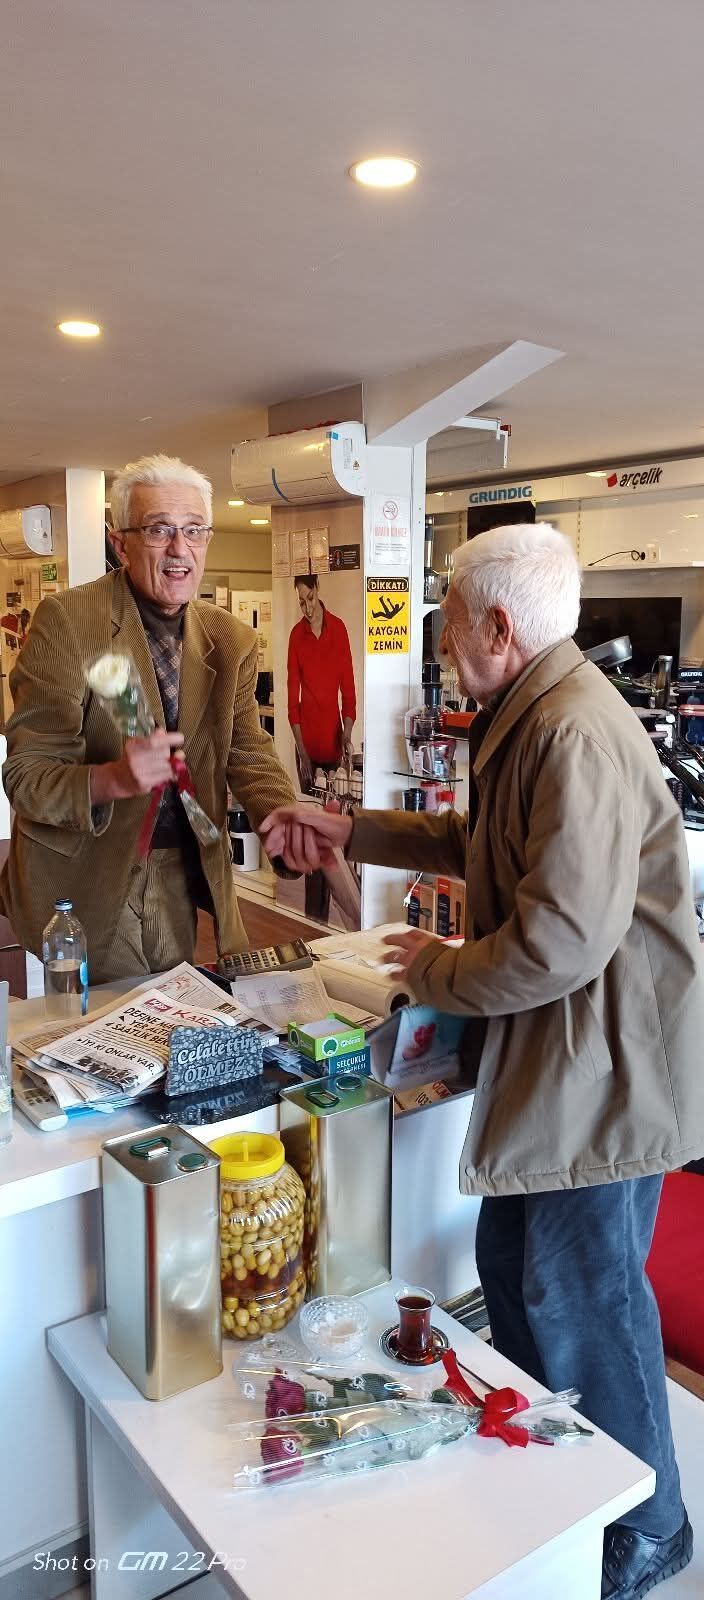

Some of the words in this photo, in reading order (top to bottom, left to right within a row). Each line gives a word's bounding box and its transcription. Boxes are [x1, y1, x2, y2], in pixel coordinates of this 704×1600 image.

[619, 467, 663, 489] arçelik
[469, 486, 533, 504] GRUNDIG
[371, 579, 405, 590] DİKKAT!
[368, 626, 408, 636] KAYGAN
[373, 638, 403, 650] ZEMİN
[105, 1047, 137, 1061] ONLAR
[184, 1056, 247, 1083] ÖLMEZ
